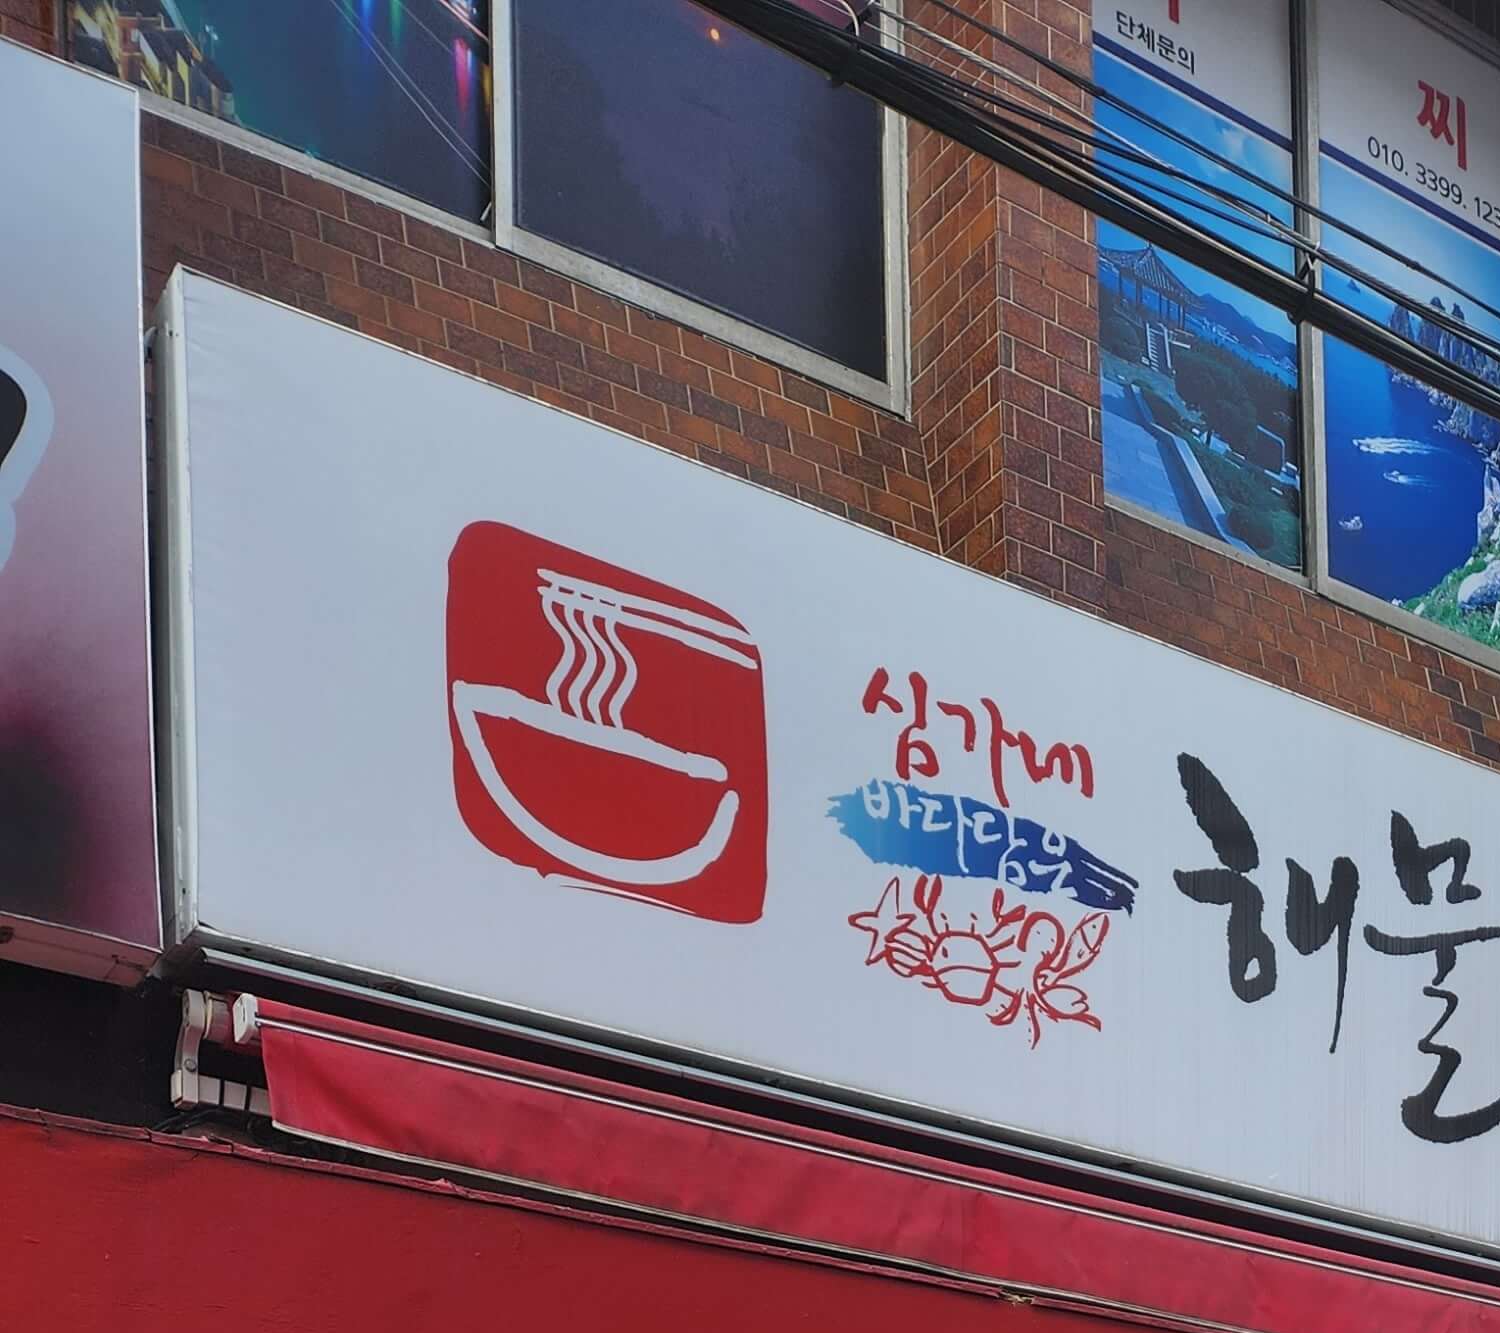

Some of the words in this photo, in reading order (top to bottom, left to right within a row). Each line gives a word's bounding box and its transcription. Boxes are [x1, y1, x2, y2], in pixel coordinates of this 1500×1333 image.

[1116, 10, 1195, 75] 단체문의
[1416, 79, 1468, 171] 찌
[862, 666, 1096, 804] 심가네
